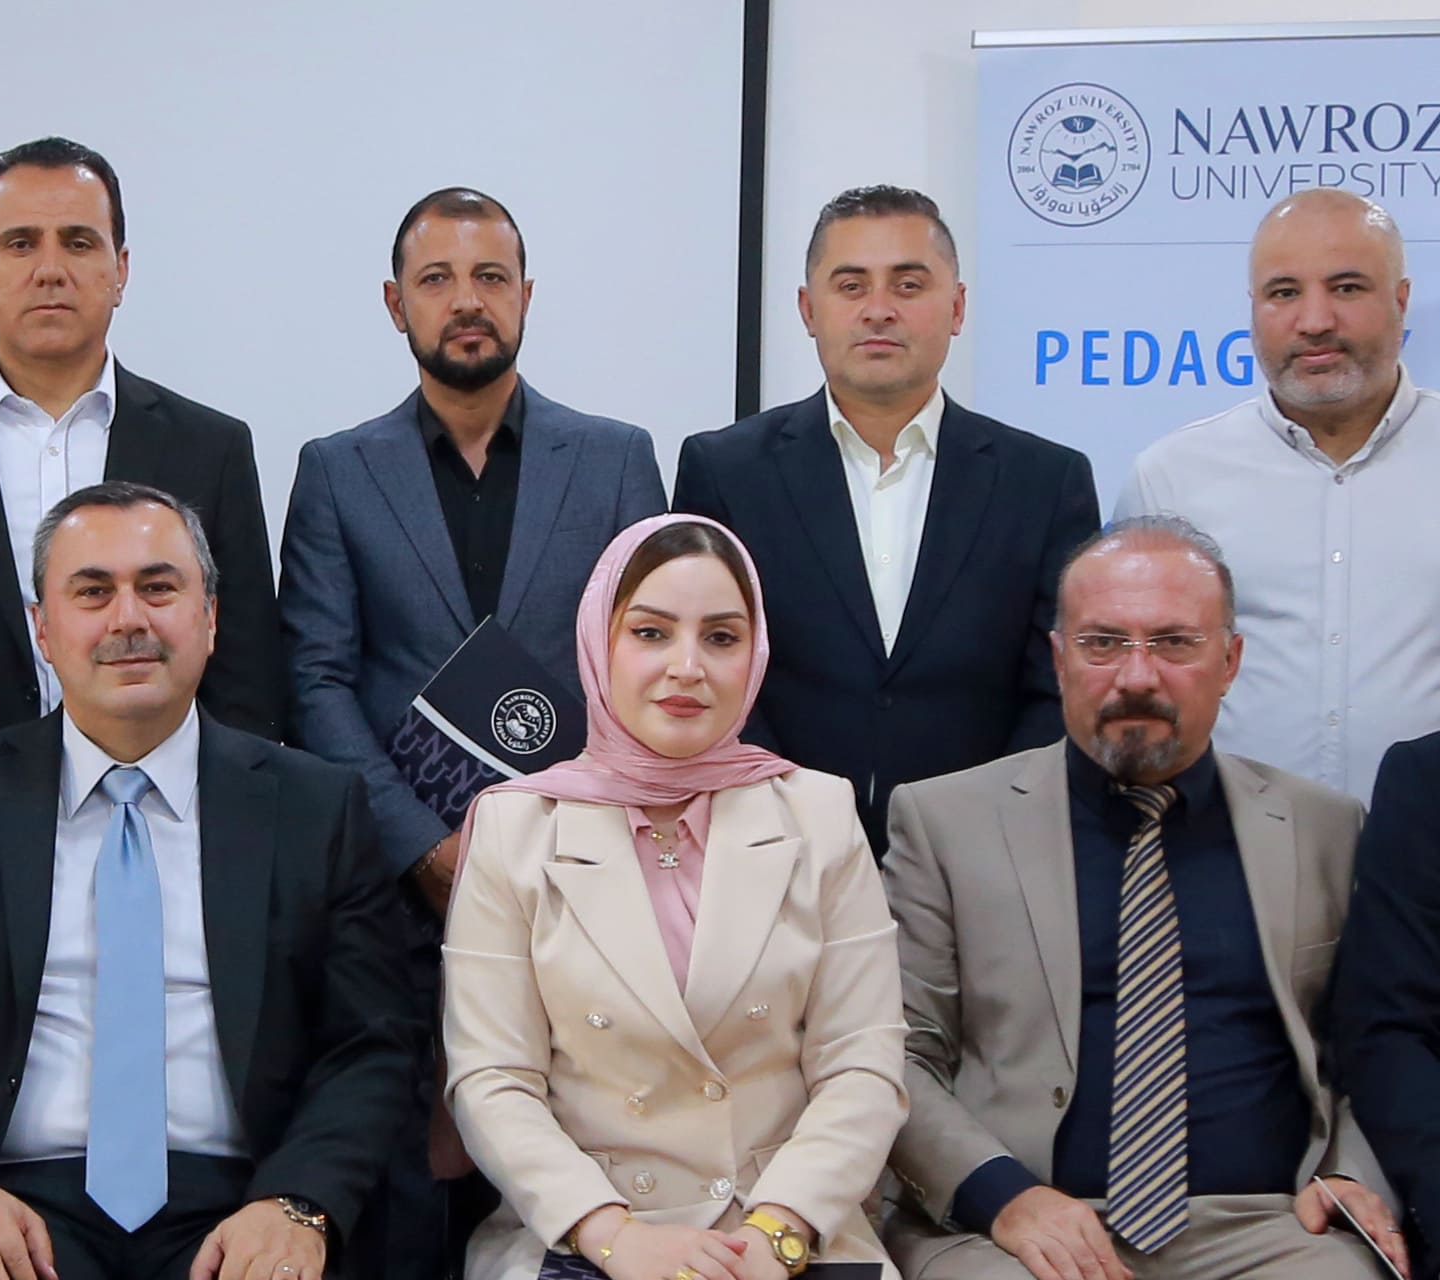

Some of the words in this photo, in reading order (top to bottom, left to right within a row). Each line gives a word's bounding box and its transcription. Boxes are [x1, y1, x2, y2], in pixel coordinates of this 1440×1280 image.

[1020, 98, 1063, 156] NAWROZ
[1069, 95, 1139, 154] UNIVERSITY
[1035, 330, 1254, 386] PEDAG
